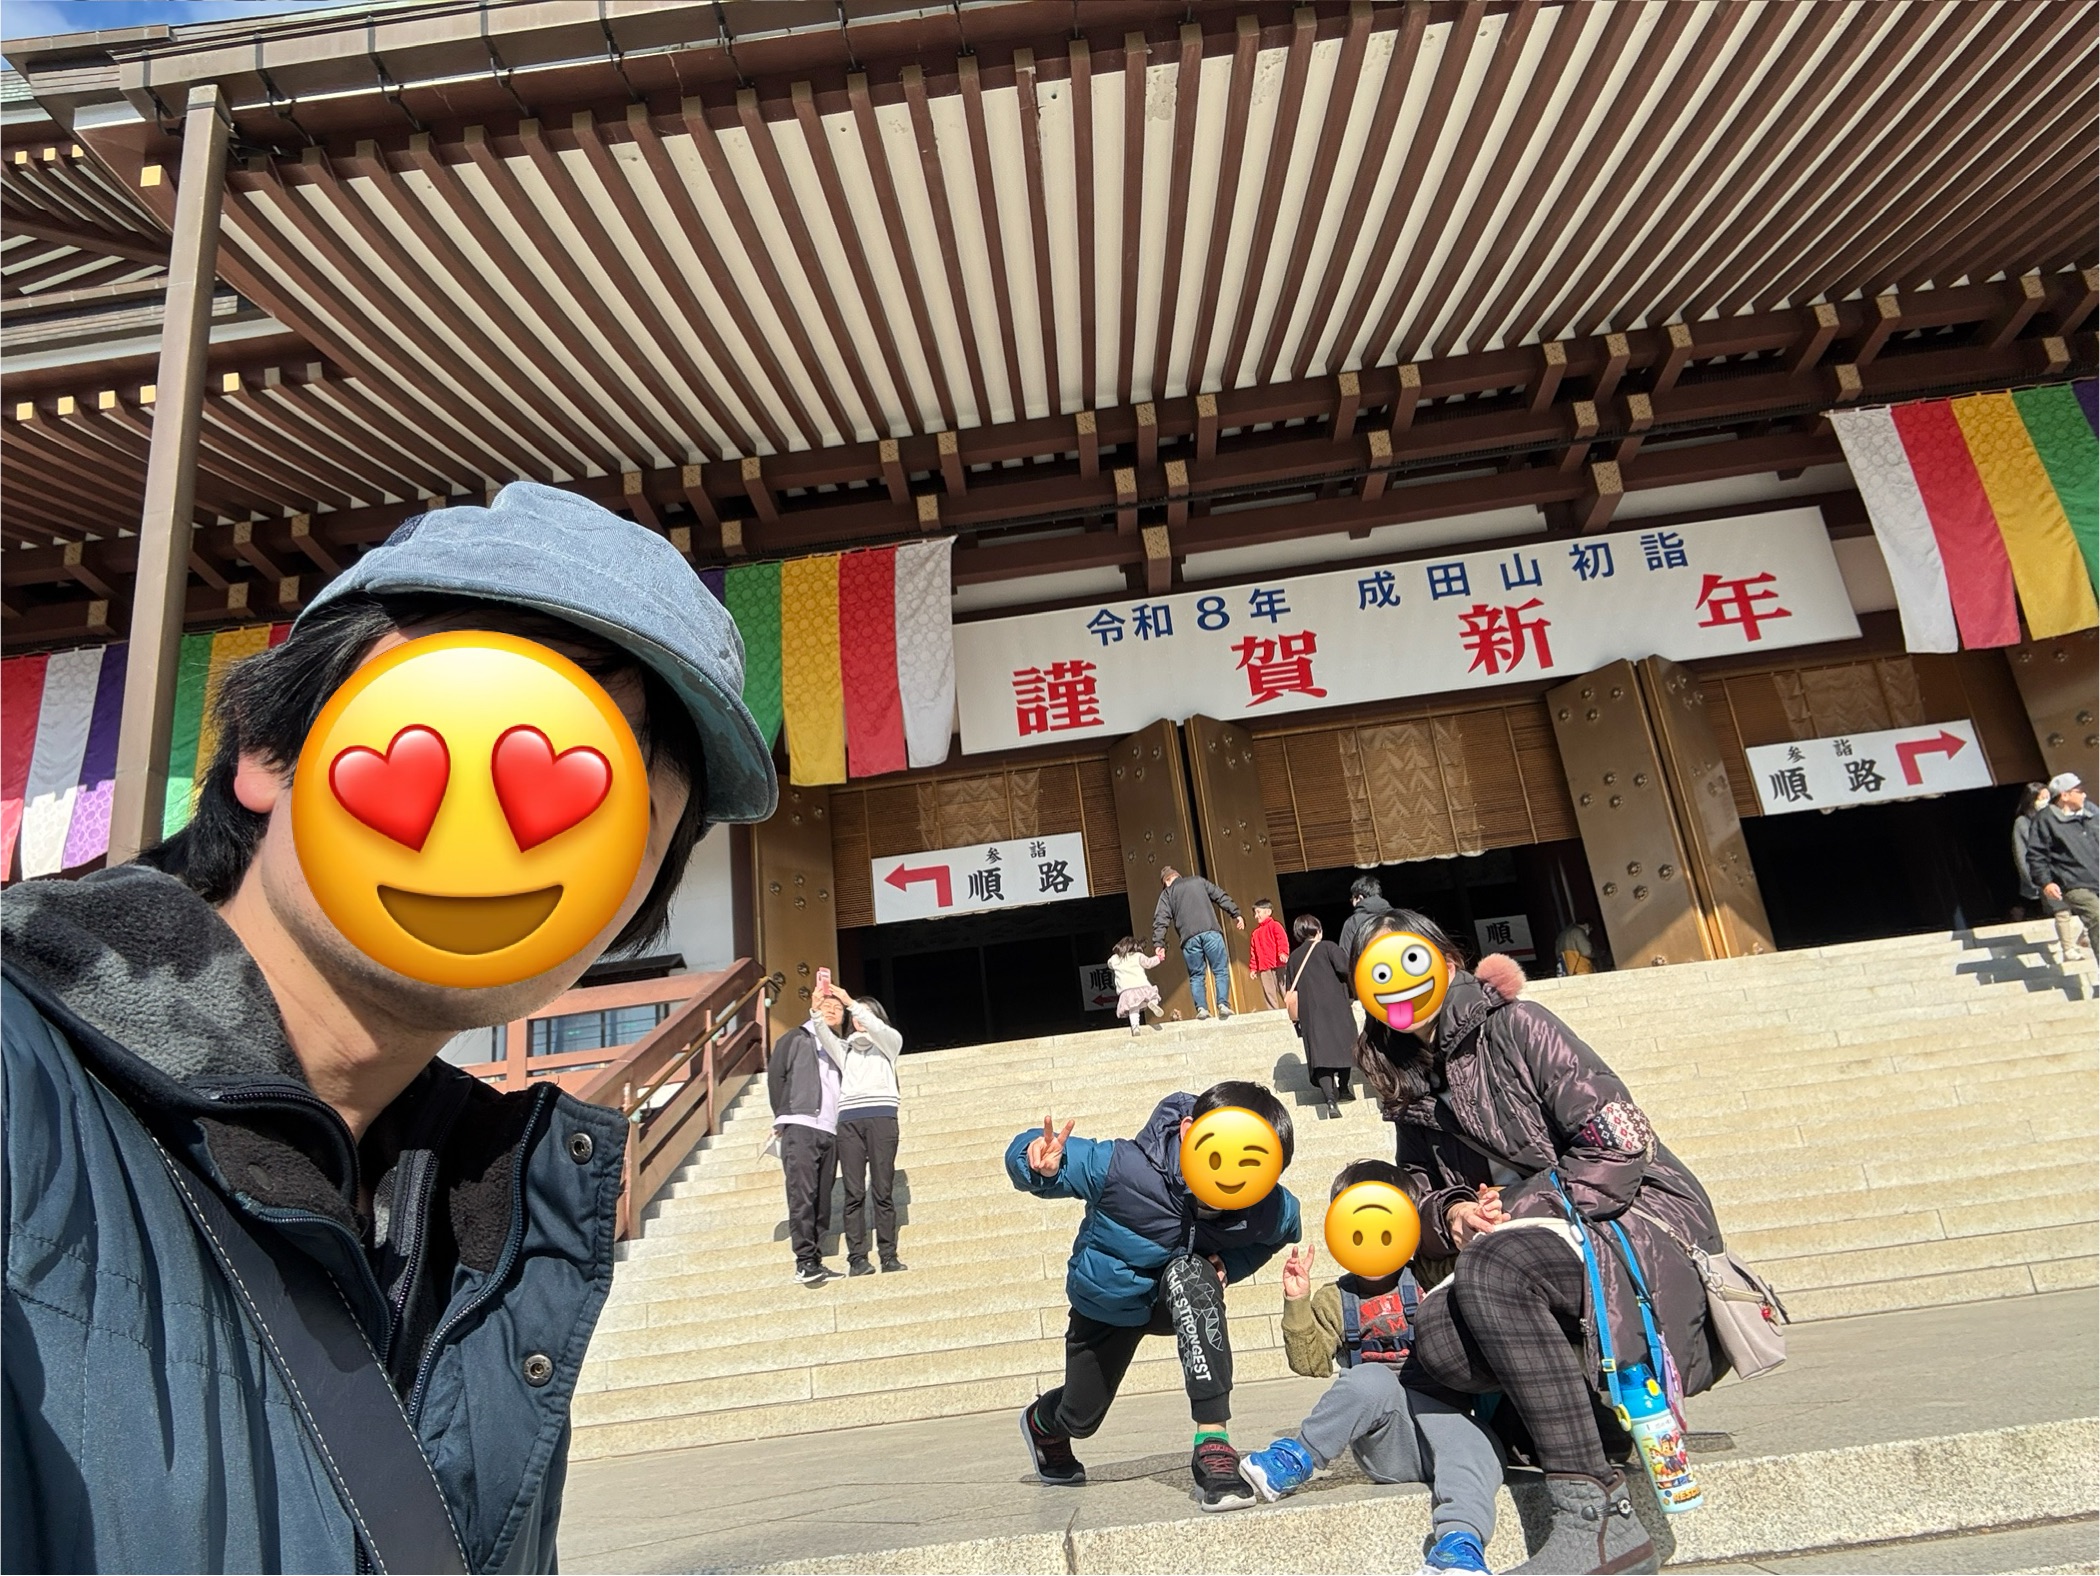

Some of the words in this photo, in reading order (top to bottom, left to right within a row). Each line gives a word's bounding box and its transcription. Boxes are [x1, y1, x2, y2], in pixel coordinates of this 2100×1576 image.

[1357, 532, 1690, 611] 成田山初詣
[1011, 571, 1792, 737] 謹賀新年
[1787, 738, 1854, 762] 参詣
[1769, 758, 1886, 803] 順路
[985, 841, 1047, 864] 参詣
[967, 859, 1075, 902] 順路
[1166, 1266, 1185, 1298] THE
[1174, 1297, 1212, 1382] STRONGEST
